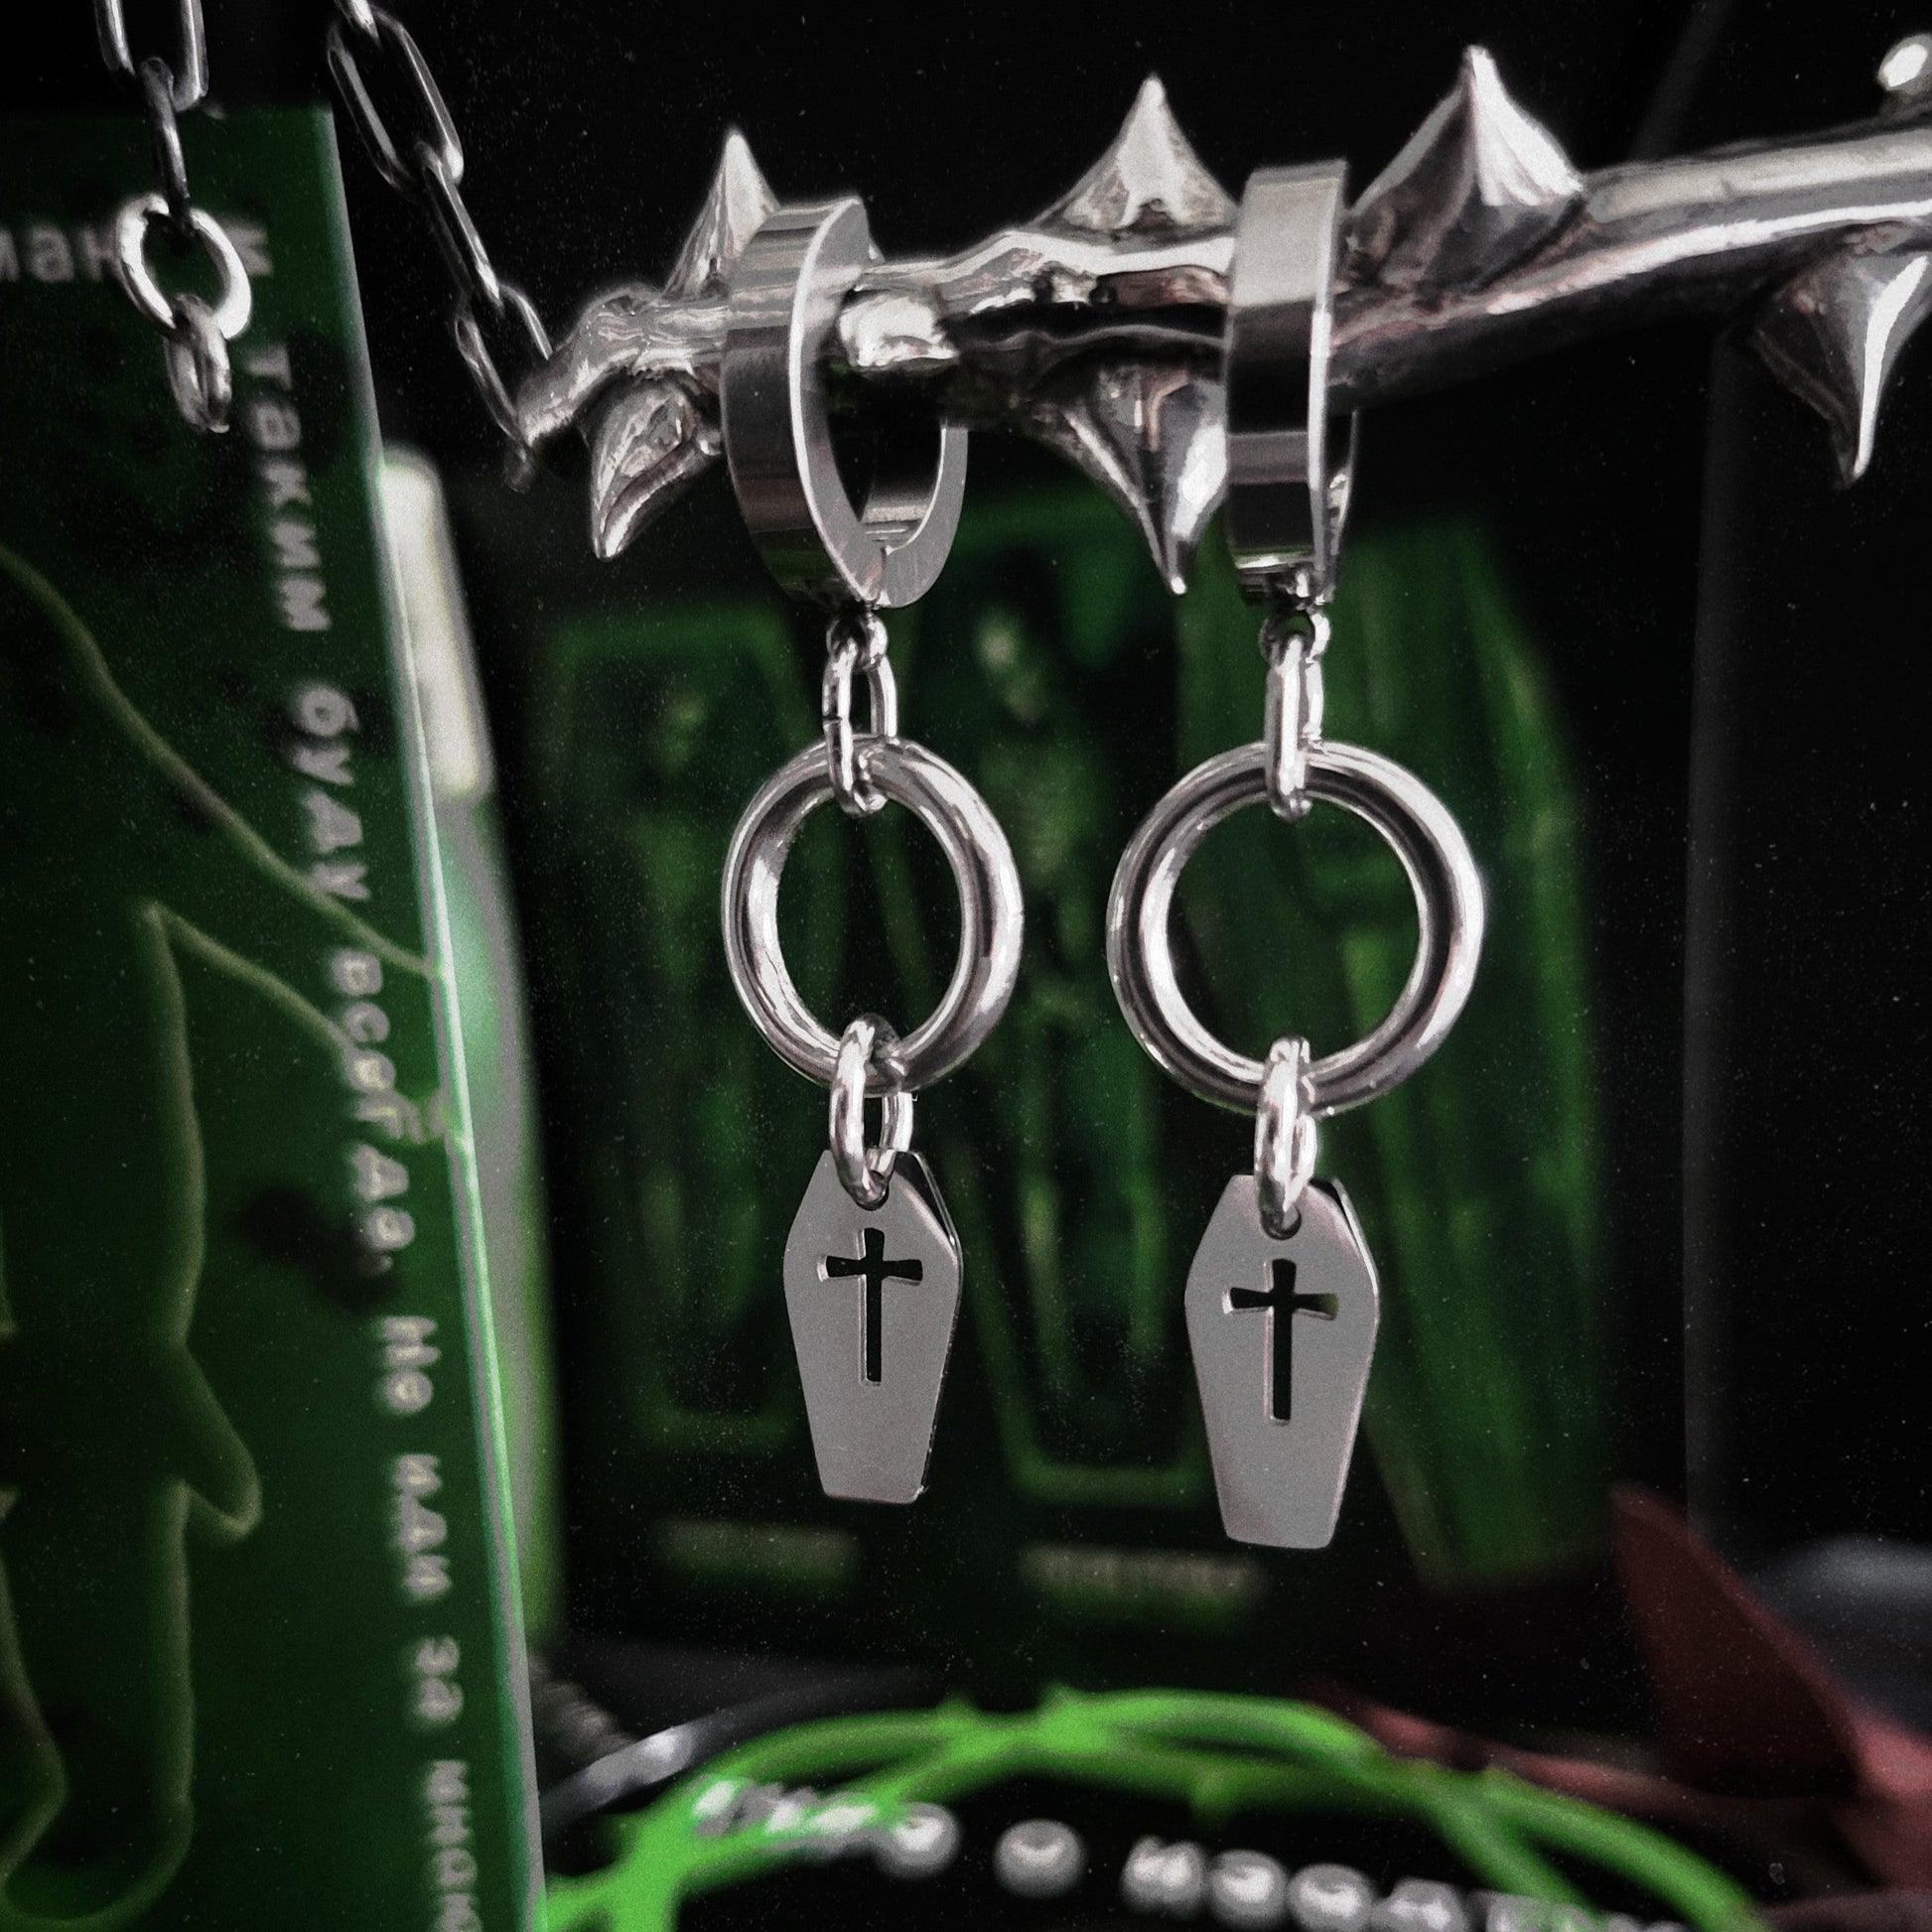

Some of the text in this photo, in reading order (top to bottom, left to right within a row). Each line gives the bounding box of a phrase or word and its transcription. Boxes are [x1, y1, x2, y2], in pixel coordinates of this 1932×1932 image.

[248, 345, 332, 630] таким
[292, 683, 371, 899] буду
[393, 1452, 452, 1600] иди
[413, 1635, 464, 1724] за
